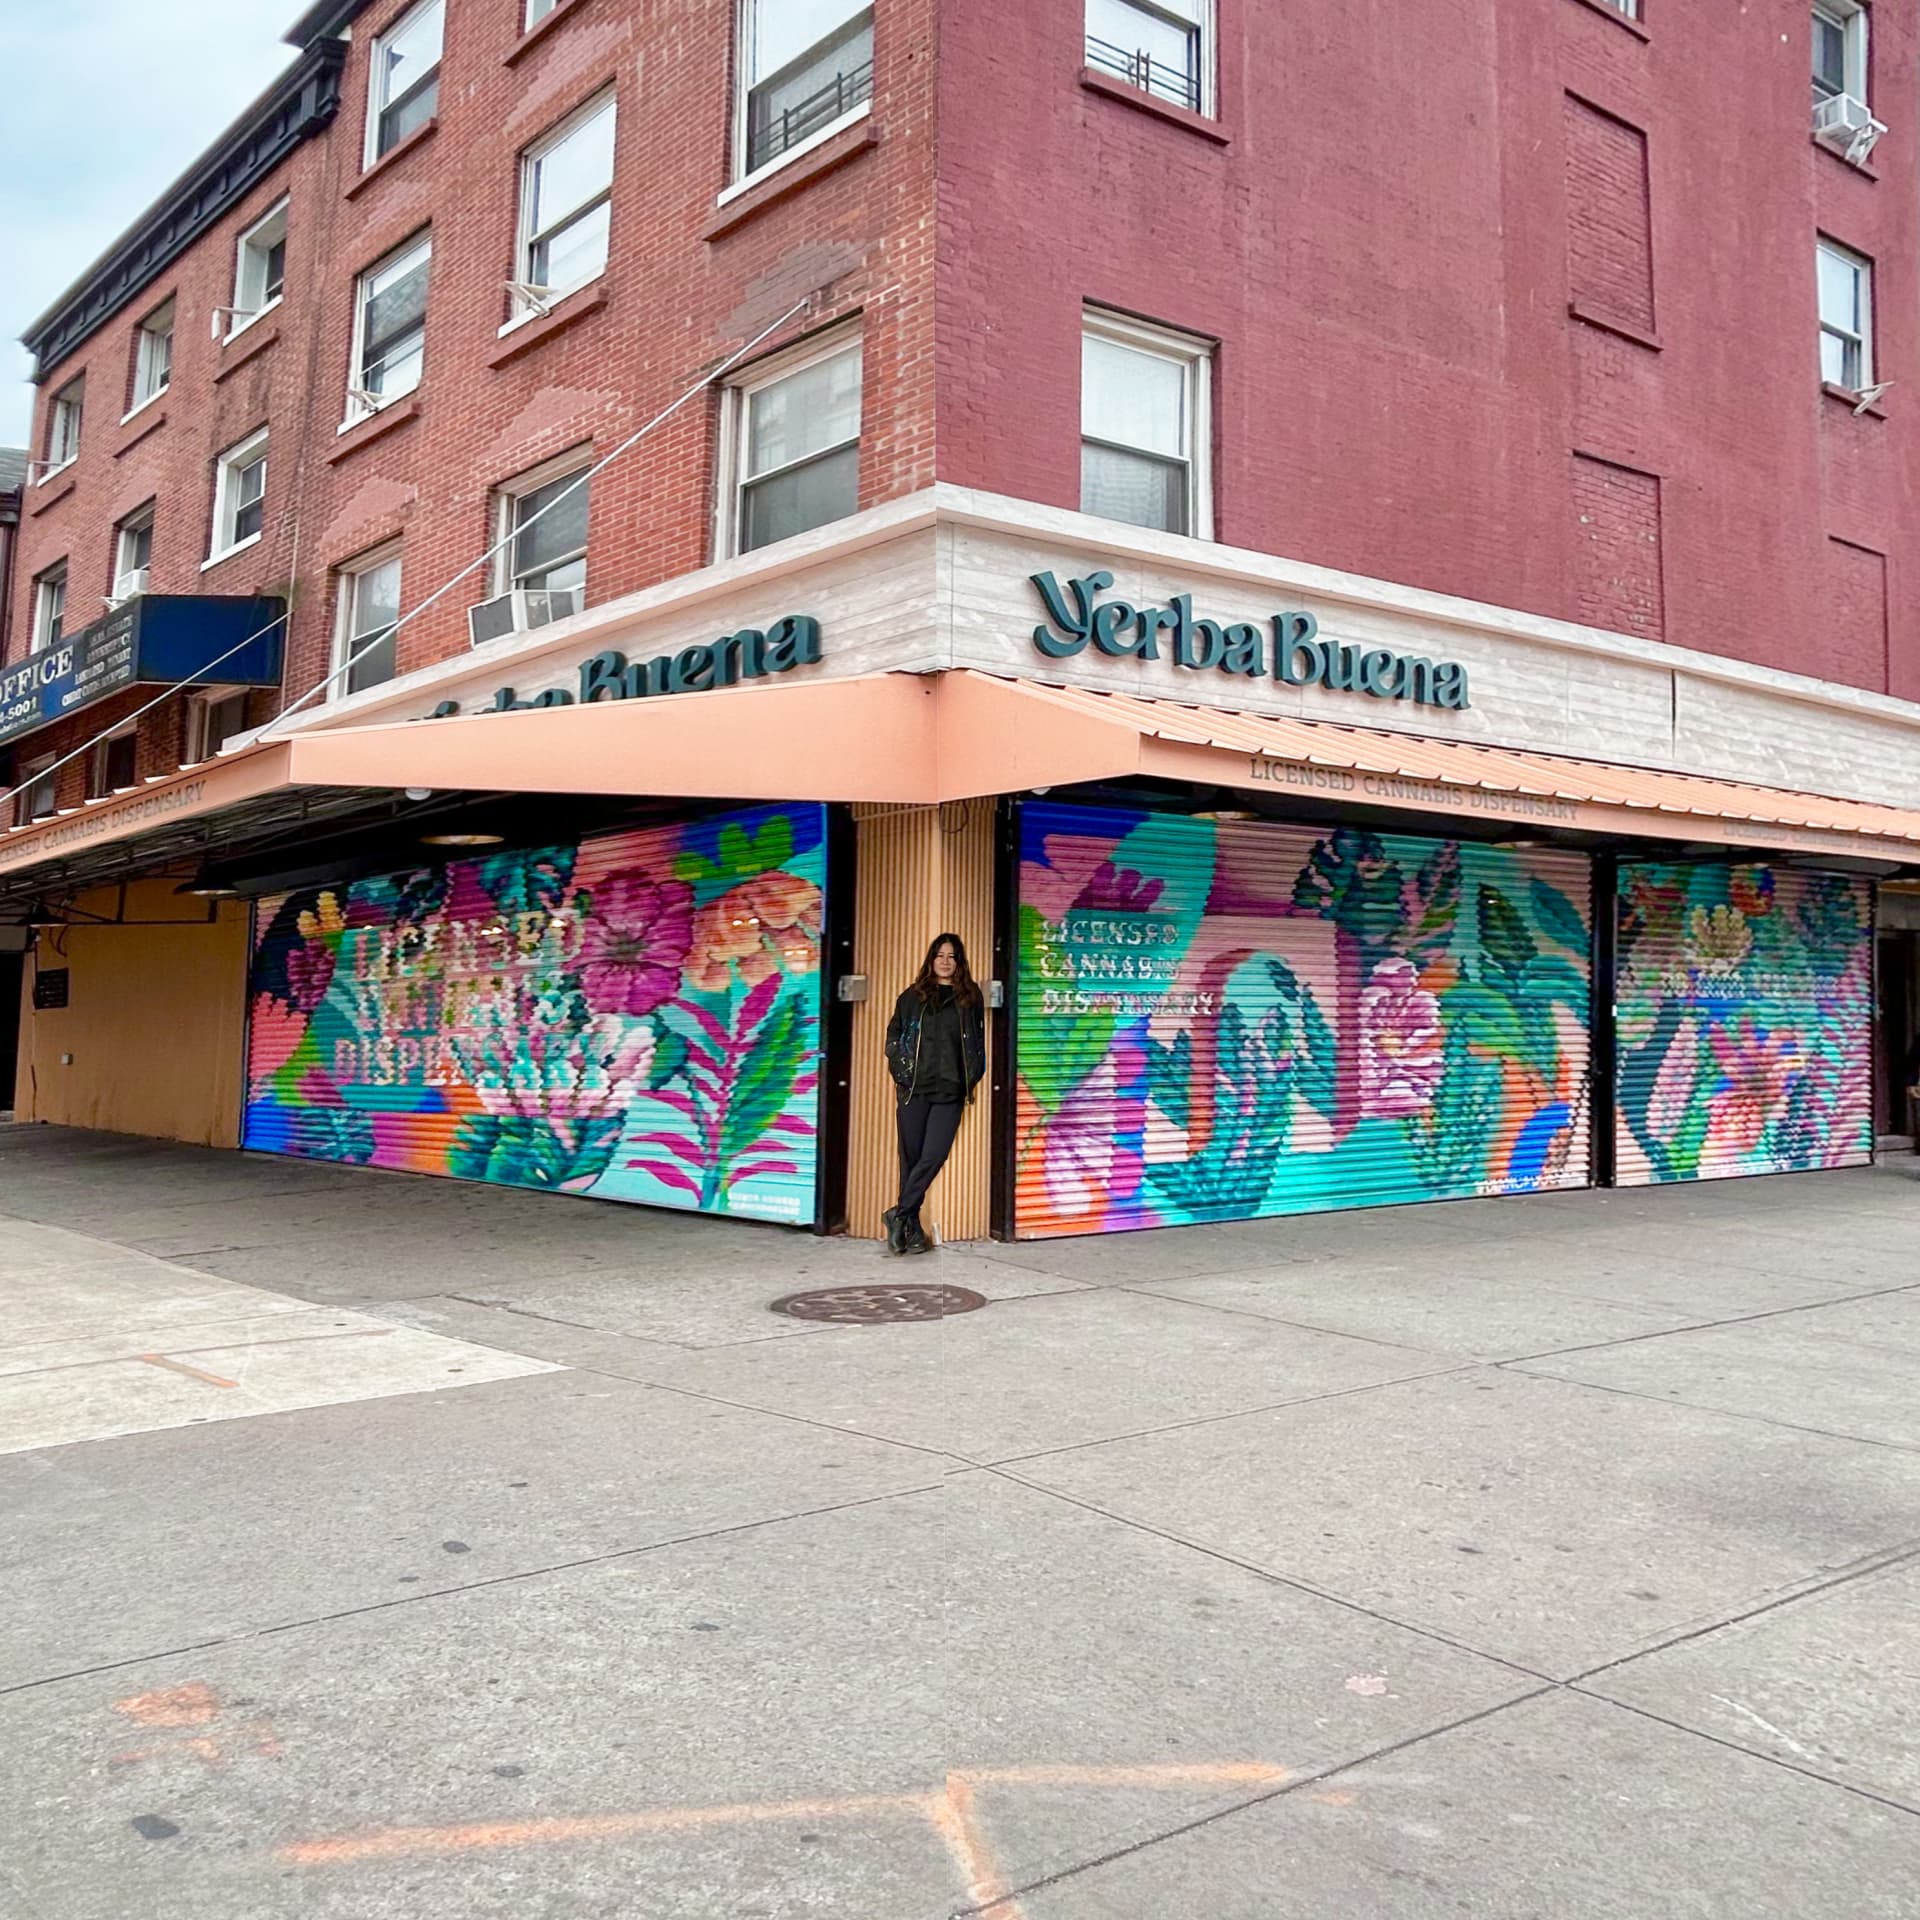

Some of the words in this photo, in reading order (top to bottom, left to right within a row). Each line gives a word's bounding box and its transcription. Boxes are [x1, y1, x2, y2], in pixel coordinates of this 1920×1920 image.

[578, 613, 822, 703] Buena
[1029, 569, 1266, 677] Yerba
[1271, 610, 1471, 711] Buena
[0, 645, 73, 705] FFICE
[43, 812, 108, 850] CANNABIS
[111, 780, 206, 828] DISPENSARY
[1250, 758, 1355, 791] LICENSED
[1363, 775, 1465, 806] CANNABIS
[1470, 789, 1578, 821] DISPENSARY
[1041, 919, 1179, 945] LICENSED
[1039, 952, 1182, 980] CANNABIS
[1042, 989, 1216, 1015] DISPENSARY
